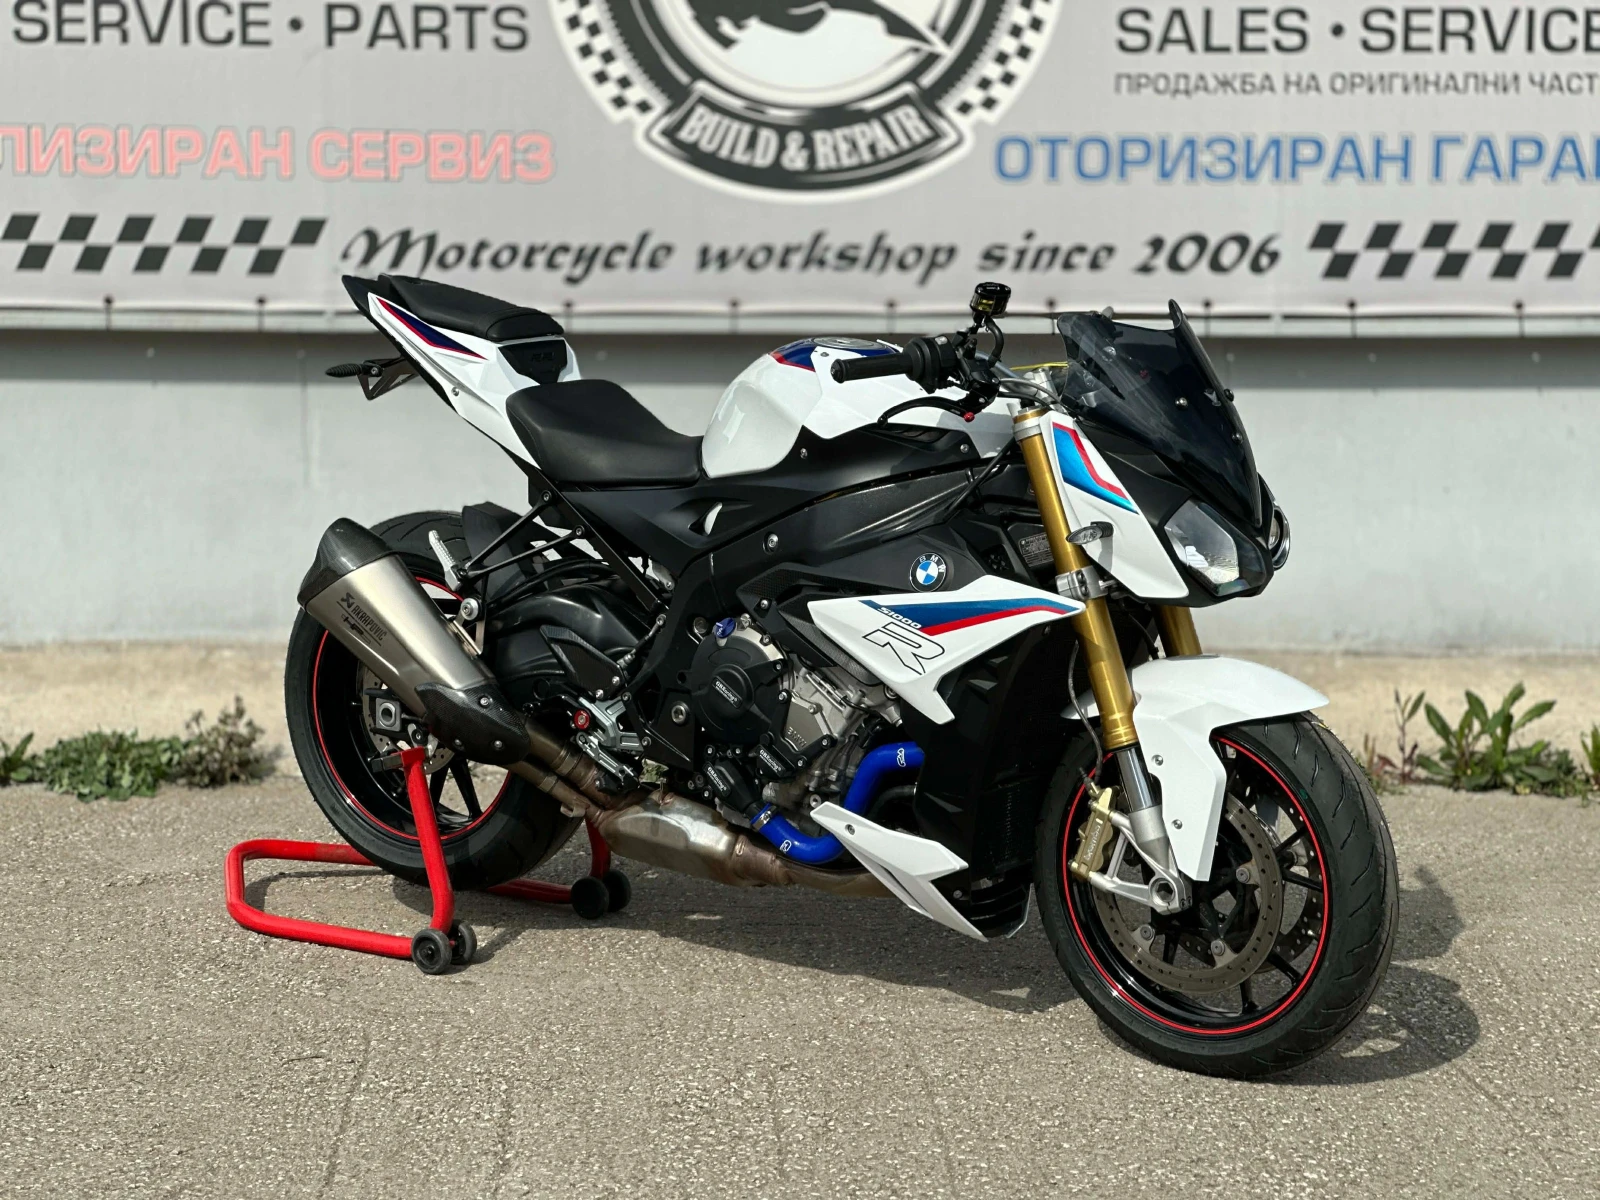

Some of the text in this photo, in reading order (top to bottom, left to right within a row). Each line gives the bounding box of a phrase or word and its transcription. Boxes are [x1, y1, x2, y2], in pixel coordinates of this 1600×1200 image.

[13, 0, 530, 51] SERVICE PARTS
[1116, 7, 1600, 54] SALES SERVICE
[1114, 72, 1599, 98] ПРОДАЖБА НА ОРИГИНАЛНИ ЧАСТ
[309, 129, 556, 182] СЕРВИЗ
[676, 103, 934, 171] BUILD & REPAIR
[994, 135, 1600, 182] ОТОРИЗИРАН ГАРА
[340, 227, 1282, 286] Motorcycle workshop since 2006
[919, 554, 946, 572] BMW
[877, 606, 923, 630] S1000
[862, 621, 946, 676] R
